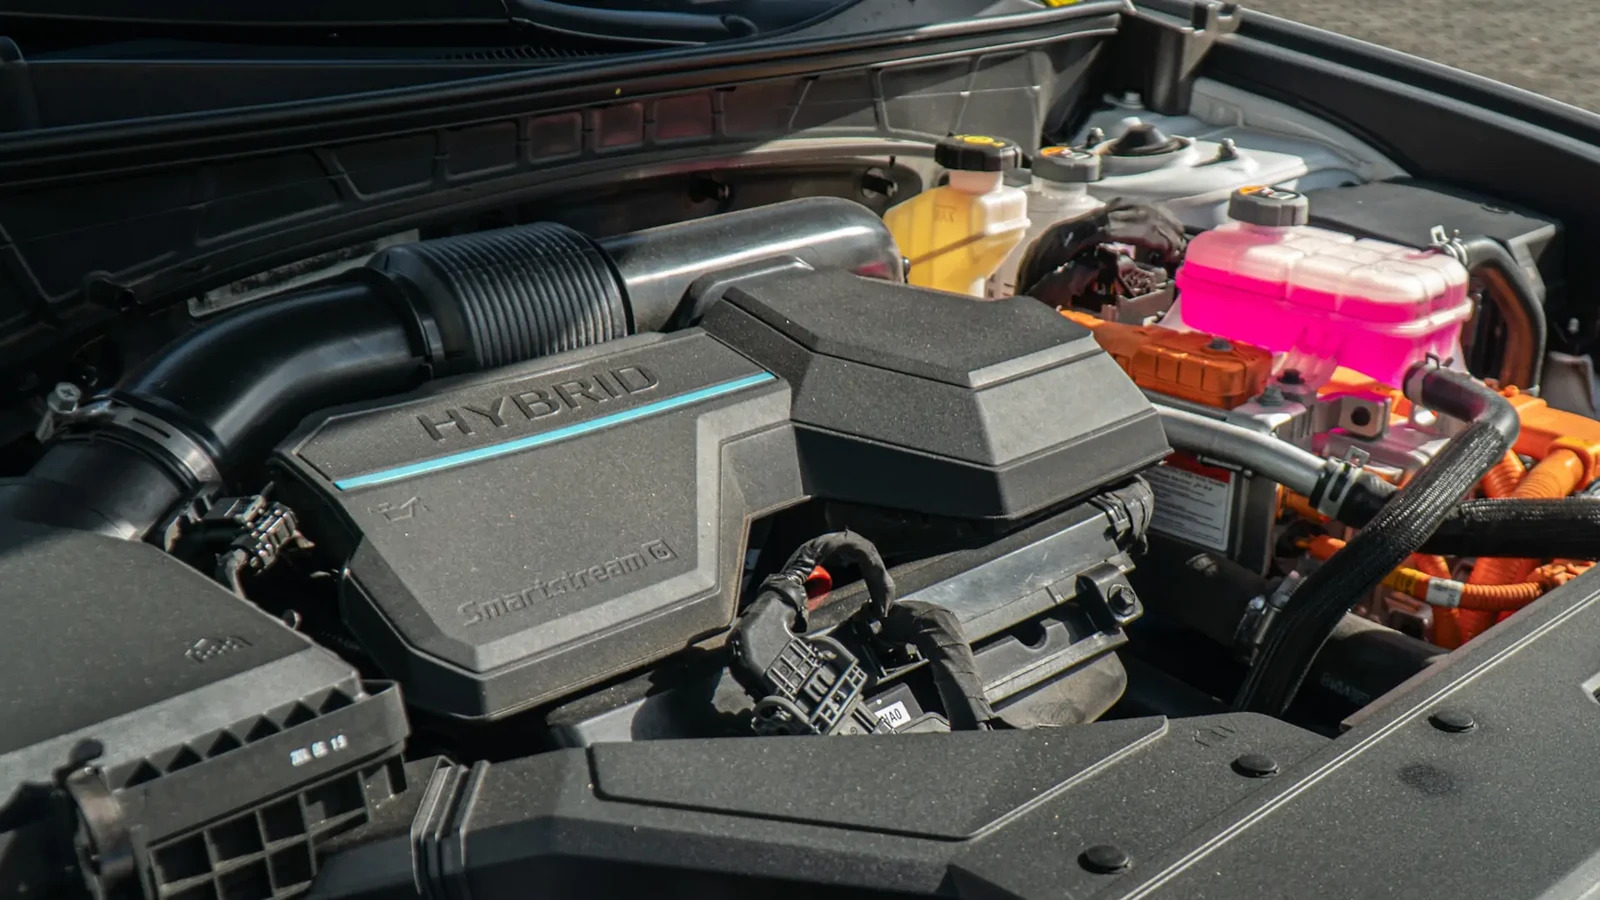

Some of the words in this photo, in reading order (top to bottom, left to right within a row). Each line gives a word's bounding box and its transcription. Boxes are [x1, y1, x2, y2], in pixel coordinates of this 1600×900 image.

[417, 366, 658, 441] HYBRID
[458, 552, 648, 627] Smartstream
[645, 539, 677, 563] G
